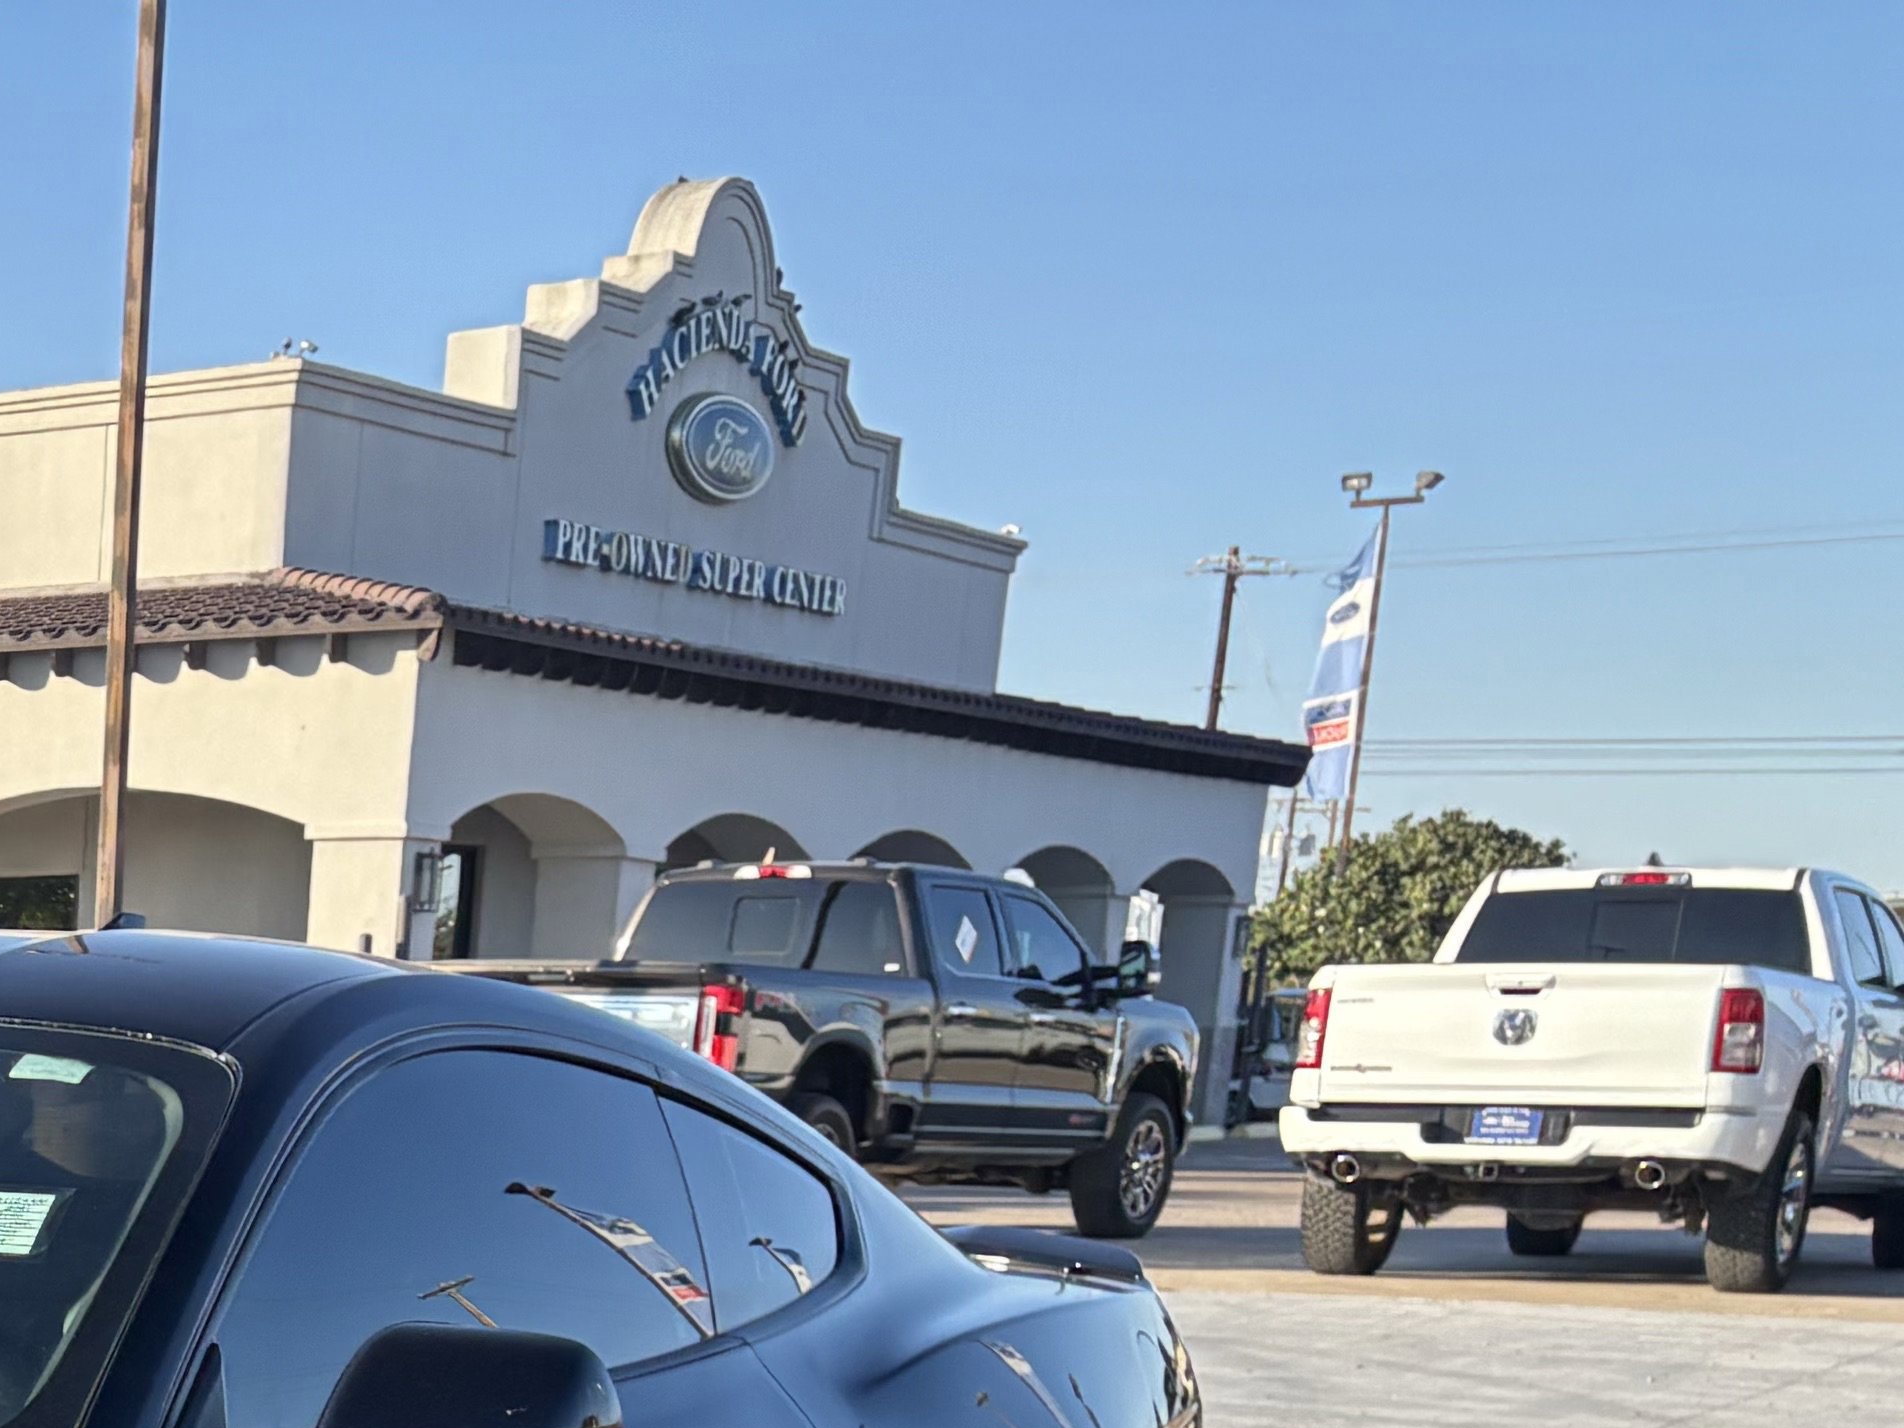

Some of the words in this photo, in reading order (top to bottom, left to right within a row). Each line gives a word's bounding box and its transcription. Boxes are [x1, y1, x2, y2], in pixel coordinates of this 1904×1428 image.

[638, 306, 757, 416] HACIENDA
[760, 336, 807, 447] FORD
[705, 417, 761, 478] Ford
[553, 519, 693, 584] PRE-OWNED
[698, 550, 767, 599] SUPER
[772, 564, 848, 614] CENTER
